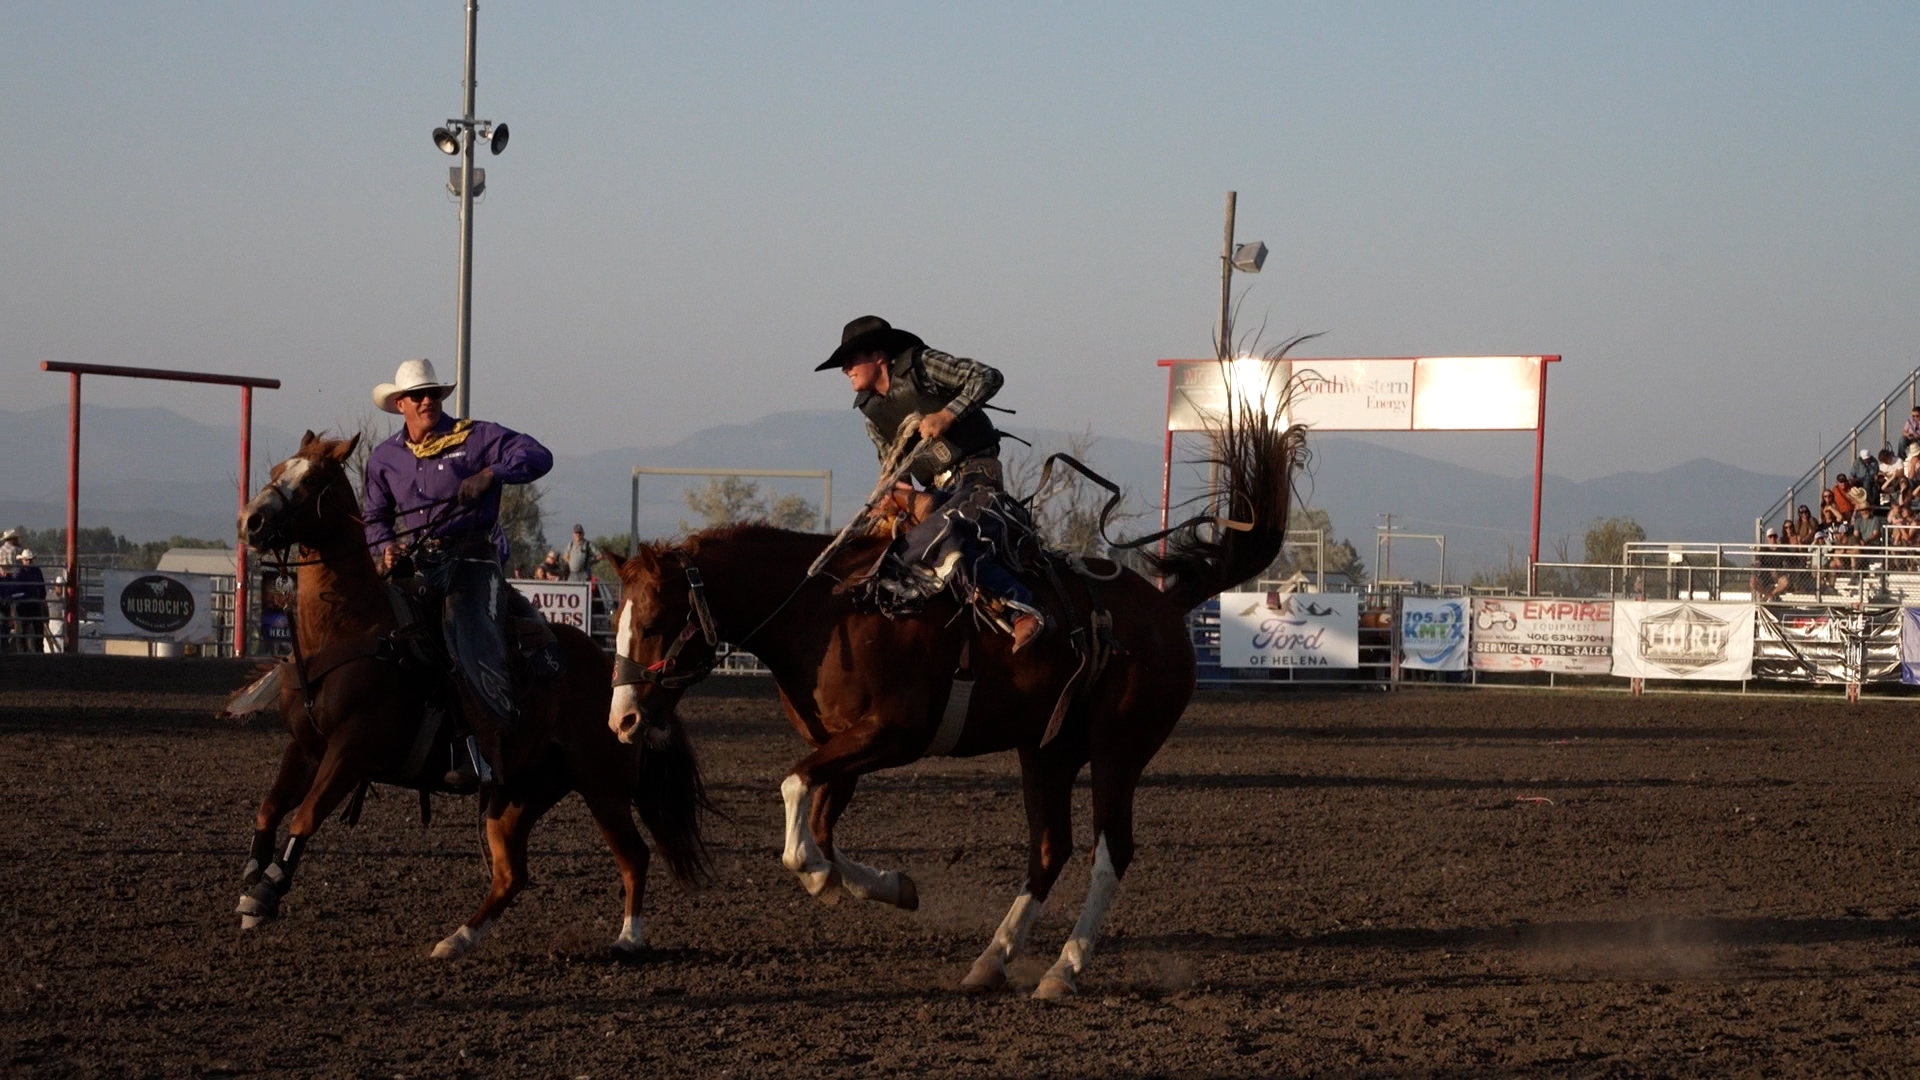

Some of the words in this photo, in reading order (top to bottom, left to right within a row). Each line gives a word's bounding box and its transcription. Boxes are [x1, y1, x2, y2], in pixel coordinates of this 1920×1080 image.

[1297, 375, 1408, 394] NorthWstern
[1367, 396, 1408, 413] Energy
[127, 597, 190, 616] MURDOCH'S
[531, 593, 580, 608] AUTO
[548, 612, 583, 626] LES
[1523, 602, 1611, 621] EMPIRE
[1252, 618, 1325, 651] Ford
[1404, 623, 1465, 639] KMTX
[1532, 622, 1597, 632] EQUIPMENT
[1250, 656, 1270, 666] OF
[1272, 656, 1328, 666] HELENA
